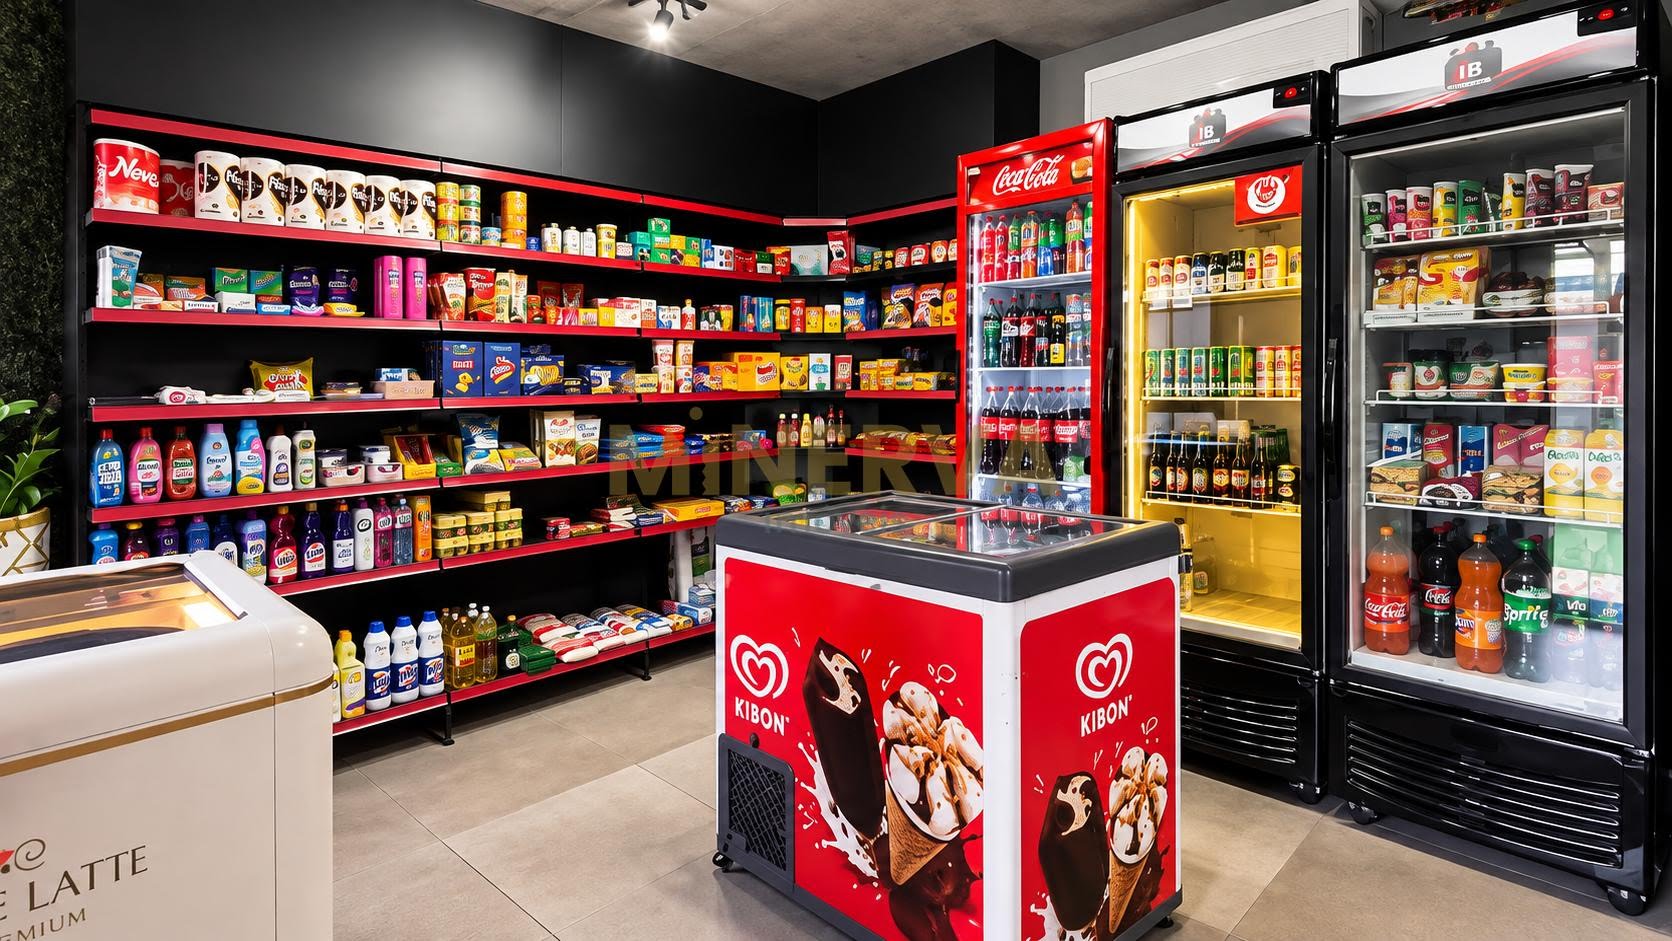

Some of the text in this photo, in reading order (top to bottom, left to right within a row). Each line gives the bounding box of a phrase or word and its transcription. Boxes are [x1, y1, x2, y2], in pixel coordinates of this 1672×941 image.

[734, 696, 786, 737] KIBON
[1080, 695, 1130, 738] KIBON
[28, 844, 149, 912] LATTE
